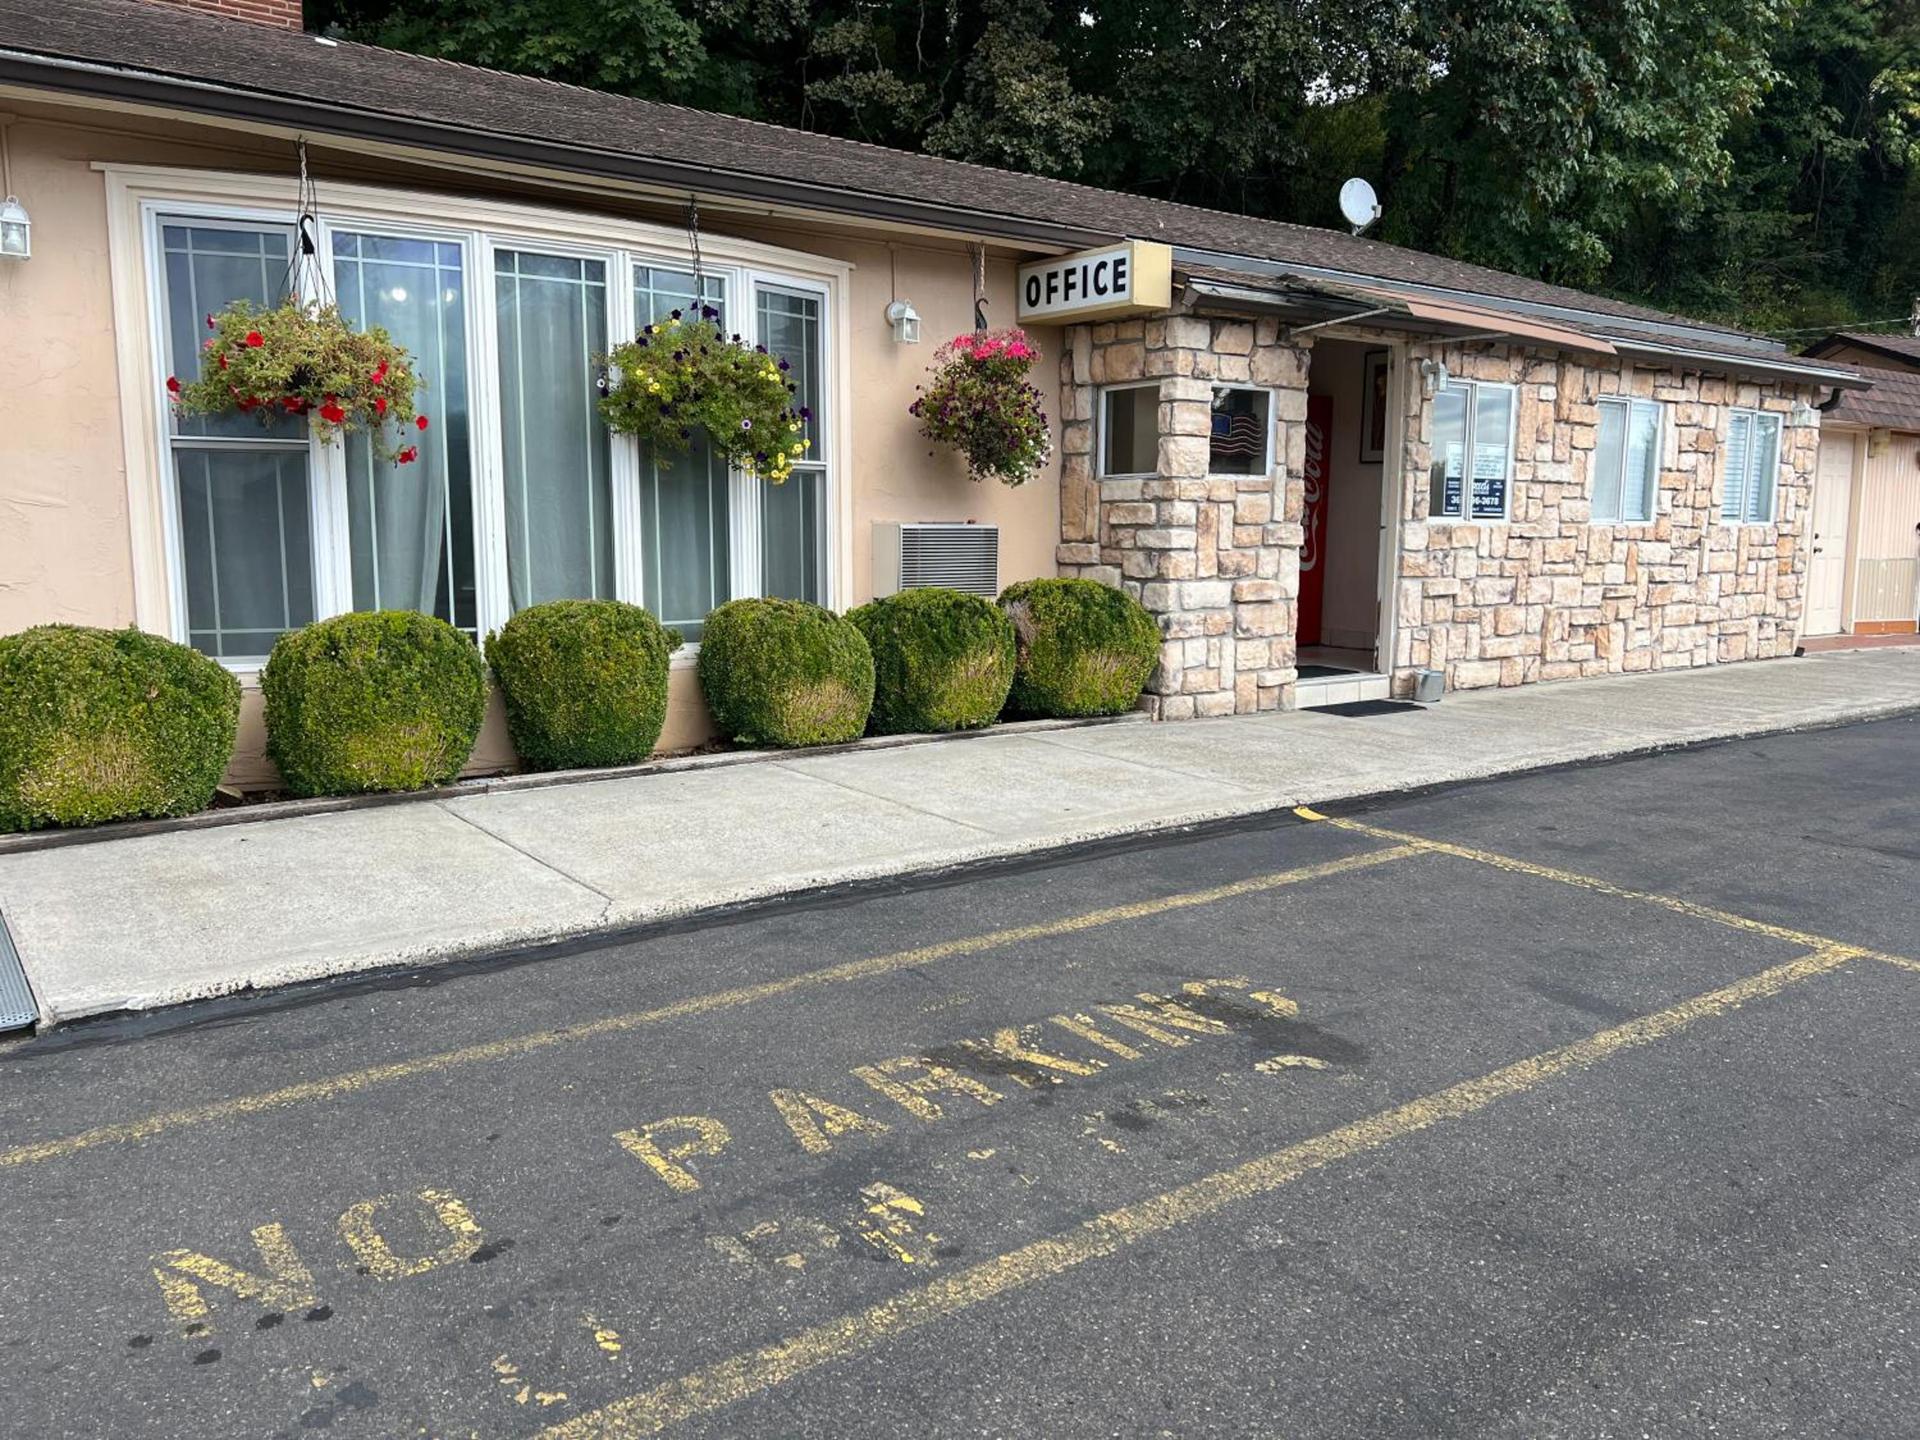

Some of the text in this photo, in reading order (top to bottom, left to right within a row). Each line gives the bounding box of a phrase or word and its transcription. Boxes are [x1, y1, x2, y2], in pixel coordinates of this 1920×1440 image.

[1025, 257, 1127, 308] OFFICE
[151, 1186, 484, 1339] NO
[612, 975, 1301, 1192] PARKING
